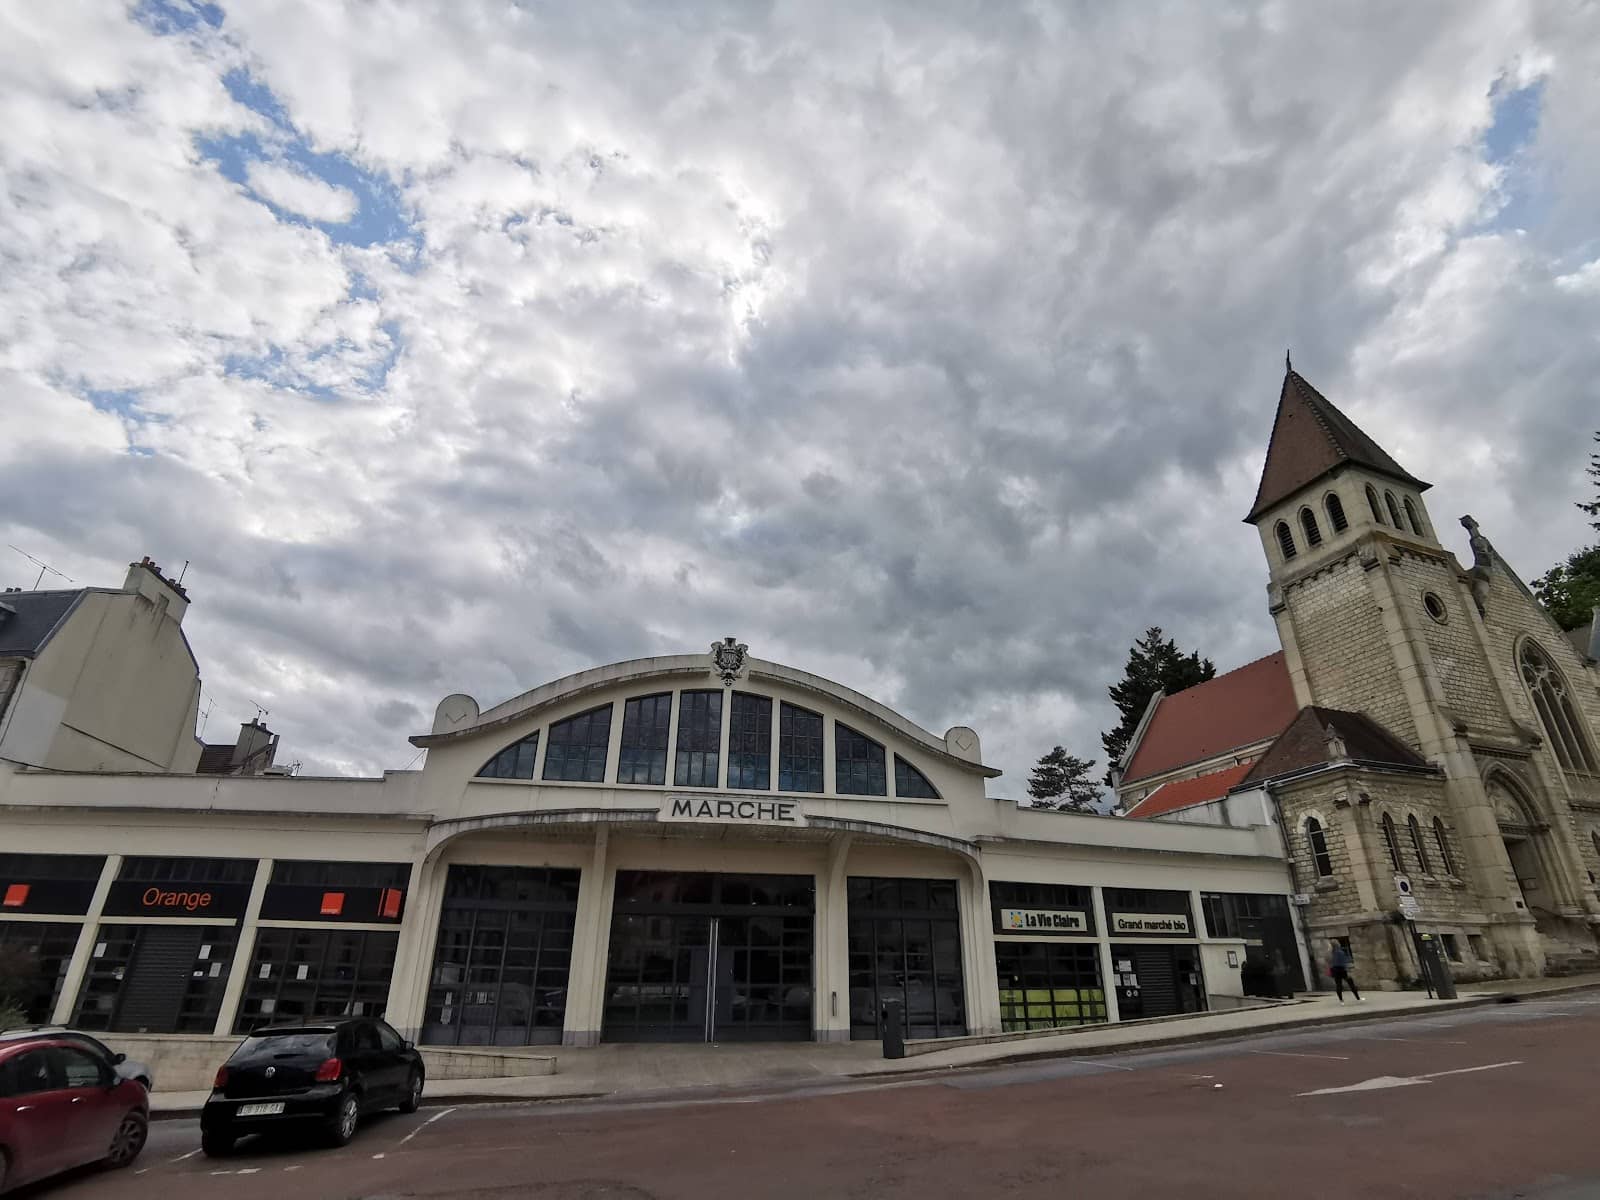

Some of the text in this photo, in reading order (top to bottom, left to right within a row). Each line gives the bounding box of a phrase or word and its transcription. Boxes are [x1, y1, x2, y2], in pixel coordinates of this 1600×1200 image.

[671, 799, 795, 822] MARCHE
[143, 887, 212, 911] Orange
[1025, 913, 1080, 928] La Vie Claire
[1118, 918, 1187, 930] Grand marché bio
